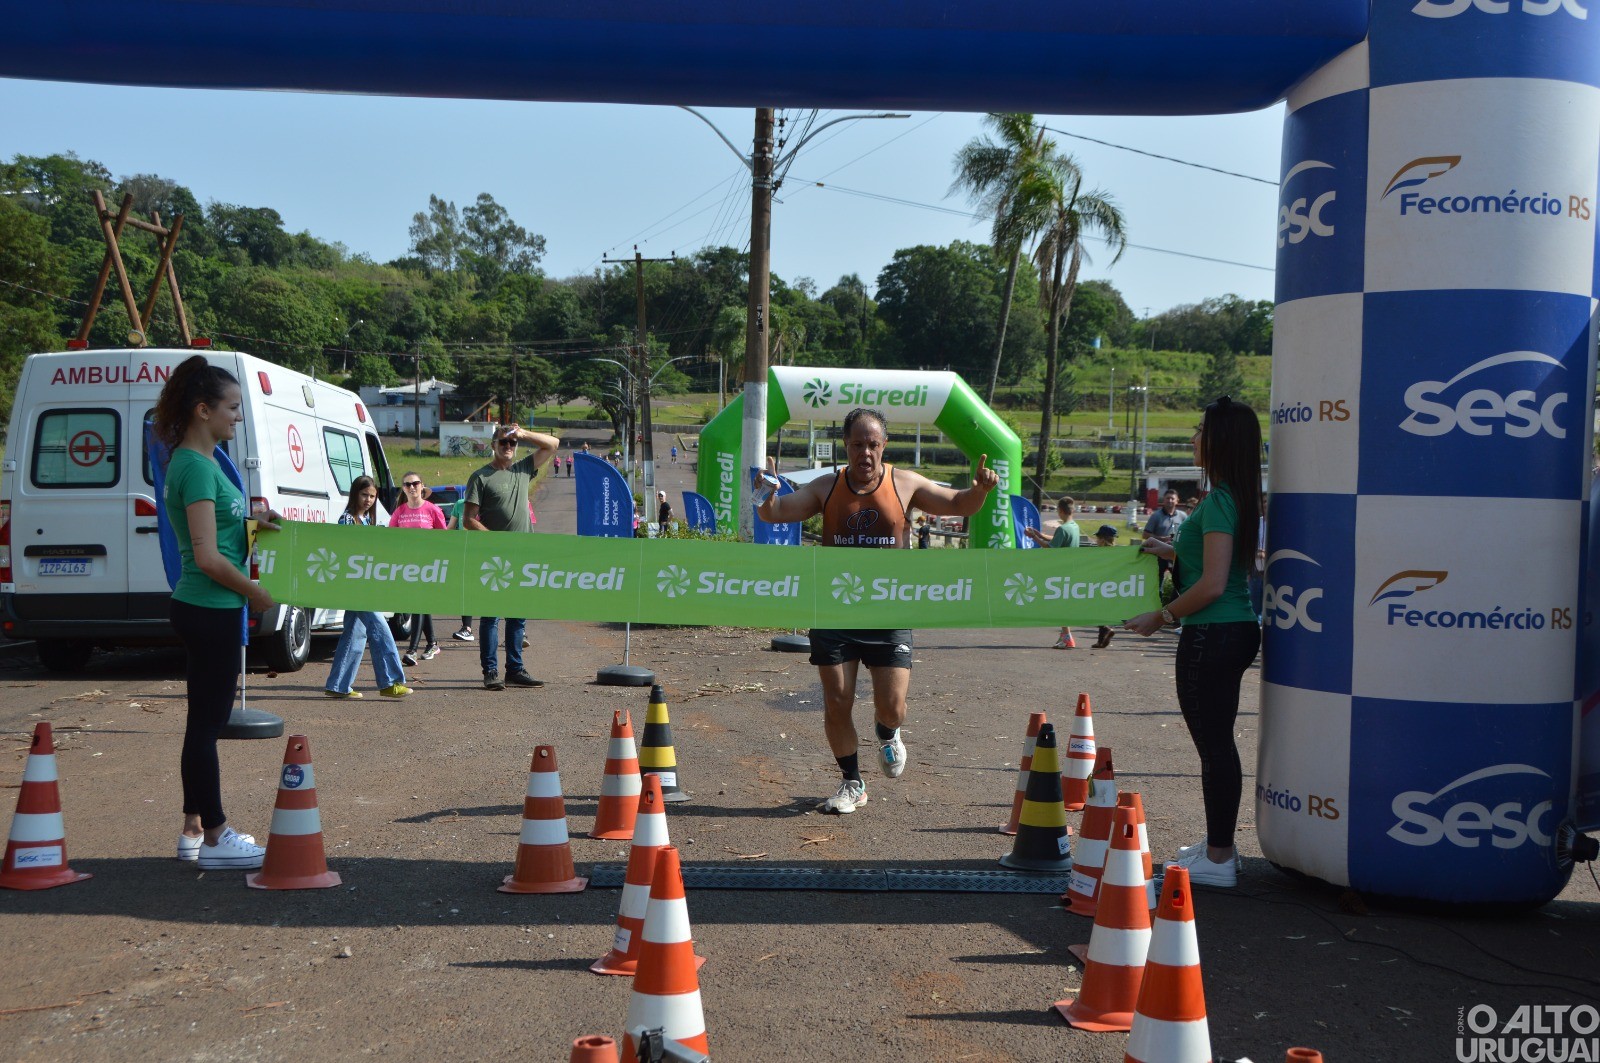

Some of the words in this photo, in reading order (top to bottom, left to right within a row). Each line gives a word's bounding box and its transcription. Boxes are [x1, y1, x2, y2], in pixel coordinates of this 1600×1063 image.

[1400, 190, 1561, 215] Fecomércio
[1568, 195, 1591, 220] RS
[838, 383, 928, 407] Sicredi
[1319, 399, 1351, 421] RS
[715, 452, 734, 522] Sicredi
[992, 459, 1009, 528] Sicredi
[834, 535, 854, 545] Med
[858, 535, 896, 545] Forma
[346, 553, 449, 584] Sicredi
[520, 563, 626, 593] Sicredi
[697, 570, 800, 599] Sicredi
[870, 577, 973, 602] Sicredi
[1043, 573, 1145, 601] Sicredi
[1387, 603, 1545, 630] Fecomércio
[1551, 607, 1573, 630] RS
[1308, 794, 1340, 820] RS
